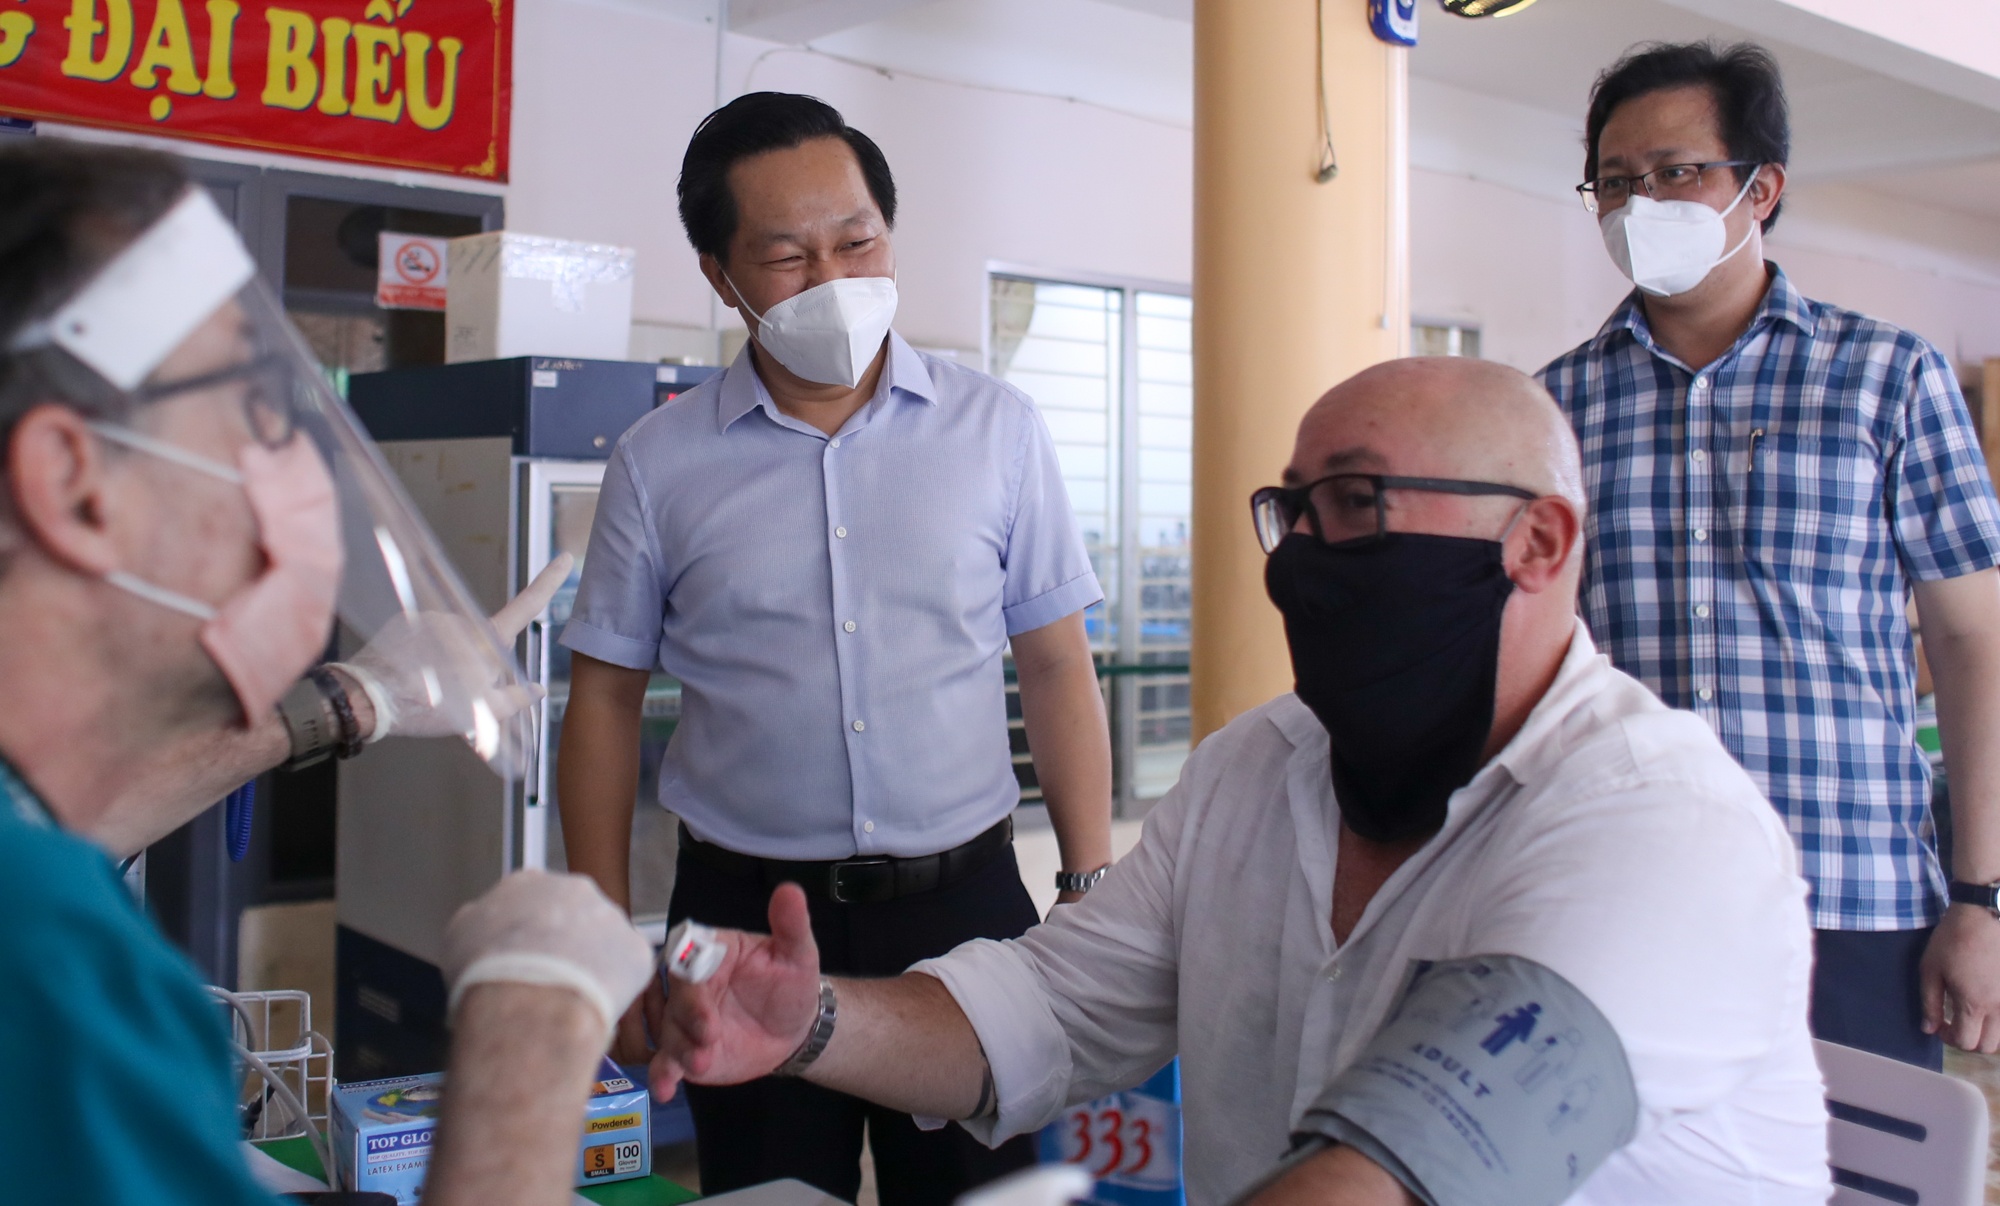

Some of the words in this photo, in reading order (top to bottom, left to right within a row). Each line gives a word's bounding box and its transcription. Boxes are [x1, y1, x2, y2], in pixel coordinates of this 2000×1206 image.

[62, 0, 239, 120] ĐẠI
[1412, 1042, 1491, 1099] ADULT
[604, 1079, 628, 1087] 100
[592, 1117, 634, 1131] Powdered
[369, 1136, 398, 1150] TOP
[401, 1131, 433, 1145] GLO
[1065, 1108, 1153, 1180] 333
[616, 1145, 639, 1160] 100
[595, 1153, 605, 1168] S
[367, 1165, 394, 1176] LATEX
[590, 1169, 609, 1177] SMALL
